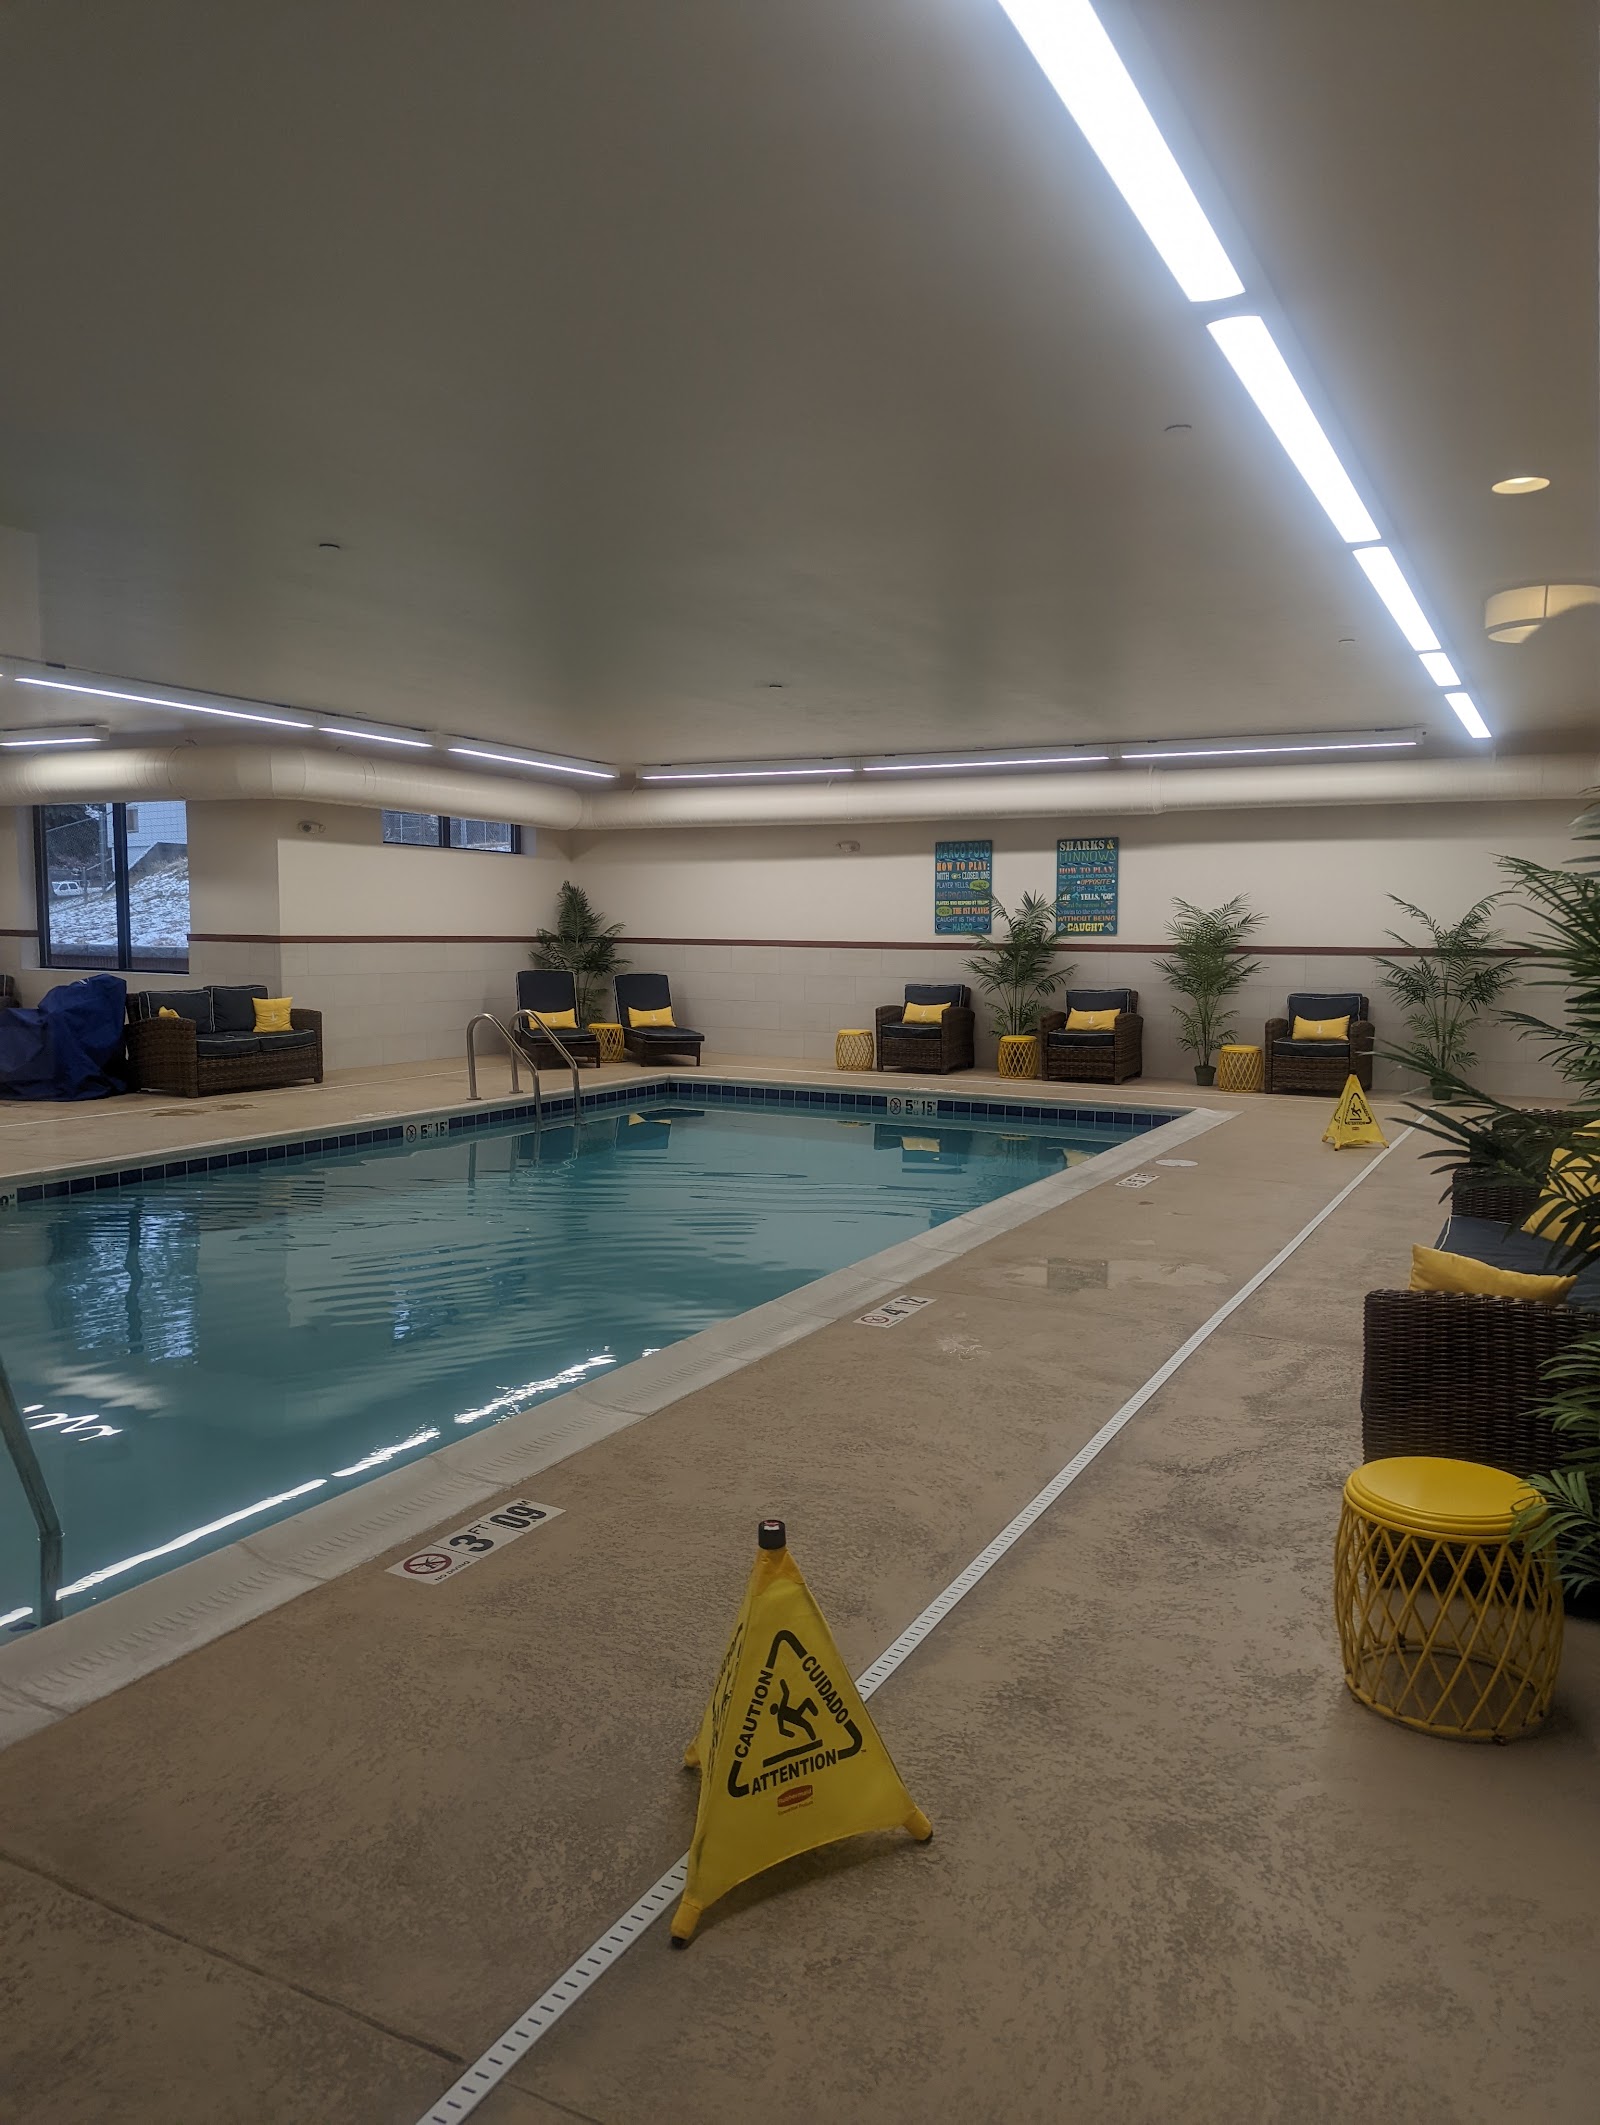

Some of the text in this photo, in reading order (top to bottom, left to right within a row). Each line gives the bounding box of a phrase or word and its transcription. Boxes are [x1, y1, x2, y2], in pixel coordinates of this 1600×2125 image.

[936, 842, 990, 858] MARCO POLO
[1059, 839, 1114, 852] SHARKS &
[1059, 850, 1117, 861] MINNOWS
[936, 861, 990, 871] HOW TO PLAY:
[936, 872, 950, 880] WITH
[980, 871, 990, 880] ONE
[952, 923, 972, 931] MARCO
[1067, 922, 1105, 932] CAUGHT
[467, 1523, 489, 1535] FT
[449, 1534, 494, 1552] 3
[802, 1656, 848, 1724] CUIDADO
[735, 1670, 773, 1758] CAUTION
[751, 1749, 837, 1795] ATTENTION
